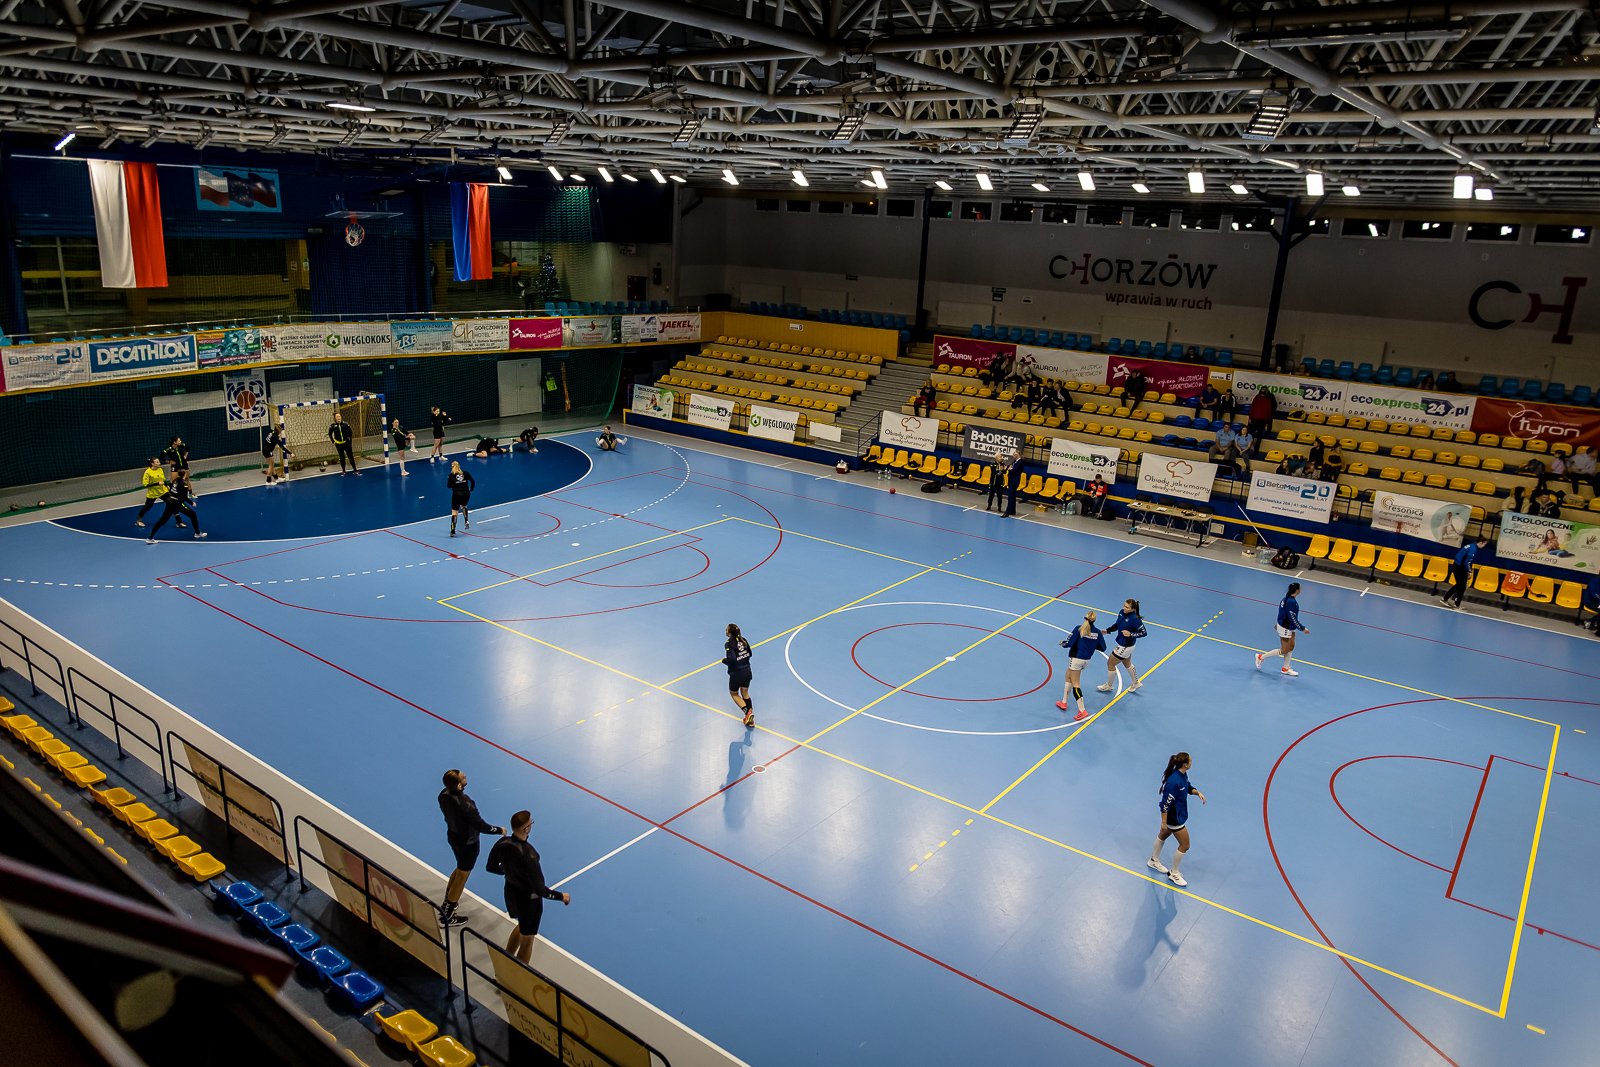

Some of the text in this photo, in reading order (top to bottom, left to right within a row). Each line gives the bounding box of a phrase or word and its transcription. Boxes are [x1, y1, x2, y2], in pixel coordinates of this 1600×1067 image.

[1105, 291, 1212, 310] wprawia w ruch
[658, 320, 692, 333] JAEKEL
[343, 334, 391, 346] WĘGLOKOKS
[96, 341, 190, 366] DECATHLON
[948, 352, 972, 361] TAURON
[1032, 364, 1059, 372] TAURON
[1350, 394, 1470, 417] ecoexpress24.pl
[762, 418, 797, 432] WĘGLOKOKS
[1348, 410, 1466, 428] ODBIÓR ODPADÓW ONLINE
[1519, 417, 1580, 438] tyron
[1144, 474, 1170, 486] Obiady
[1188, 484, 1210, 494] mamy
[1300, 482, 1330, 500] 20
[1388, 506, 1424, 516] resonica
[1512, 516, 1576, 531] EKOLOGICZNE
[1503, 528, 1545, 540] CZYSTOŚCI
[1498, 550, 1558, 564] www.biopur.org
[1508, 573, 1520, 584] 33
